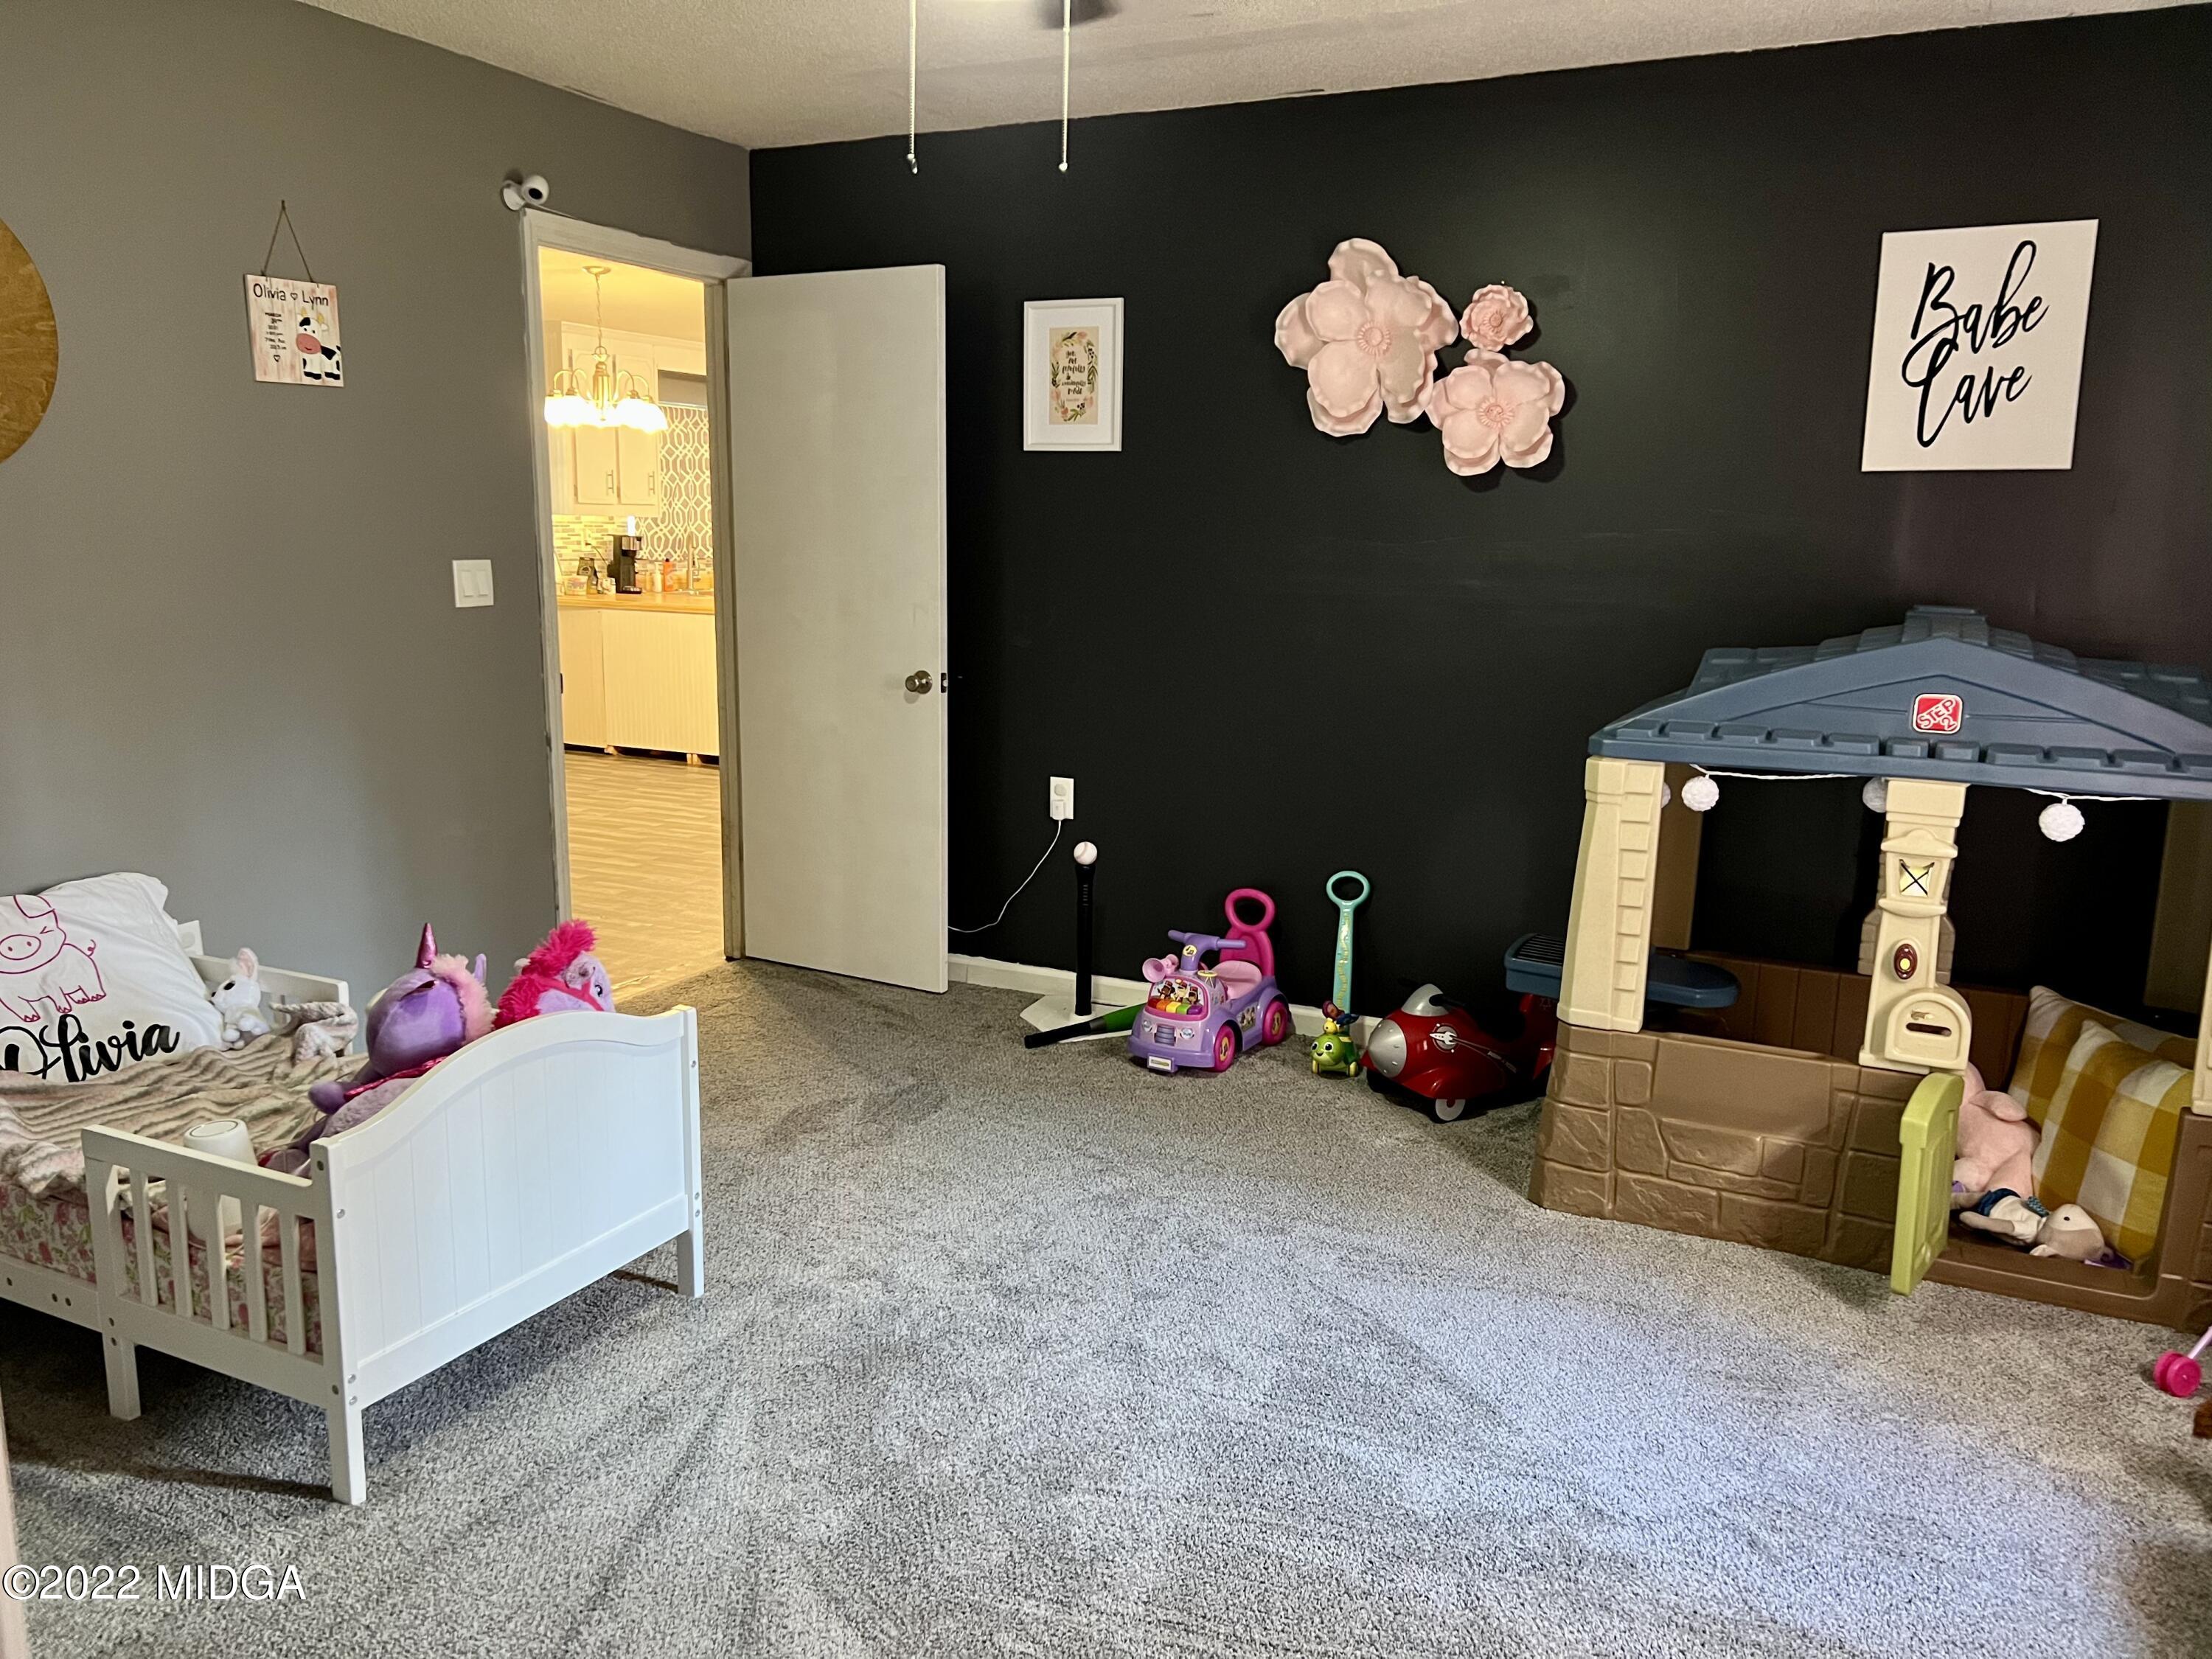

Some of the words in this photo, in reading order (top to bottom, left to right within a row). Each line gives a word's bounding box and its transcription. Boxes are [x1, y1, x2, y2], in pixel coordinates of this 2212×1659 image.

[253, 283, 287, 301] Olivia
[302, 290, 329, 310] Lynn
[1911, 240, 2051, 355] Babe
[1902, 328, 2033, 448] Cave
[1918, 698, 1955, 728] STEP
[1941, 716, 1957, 729] 2
[0, 1014, 180, 1082] Olivia
